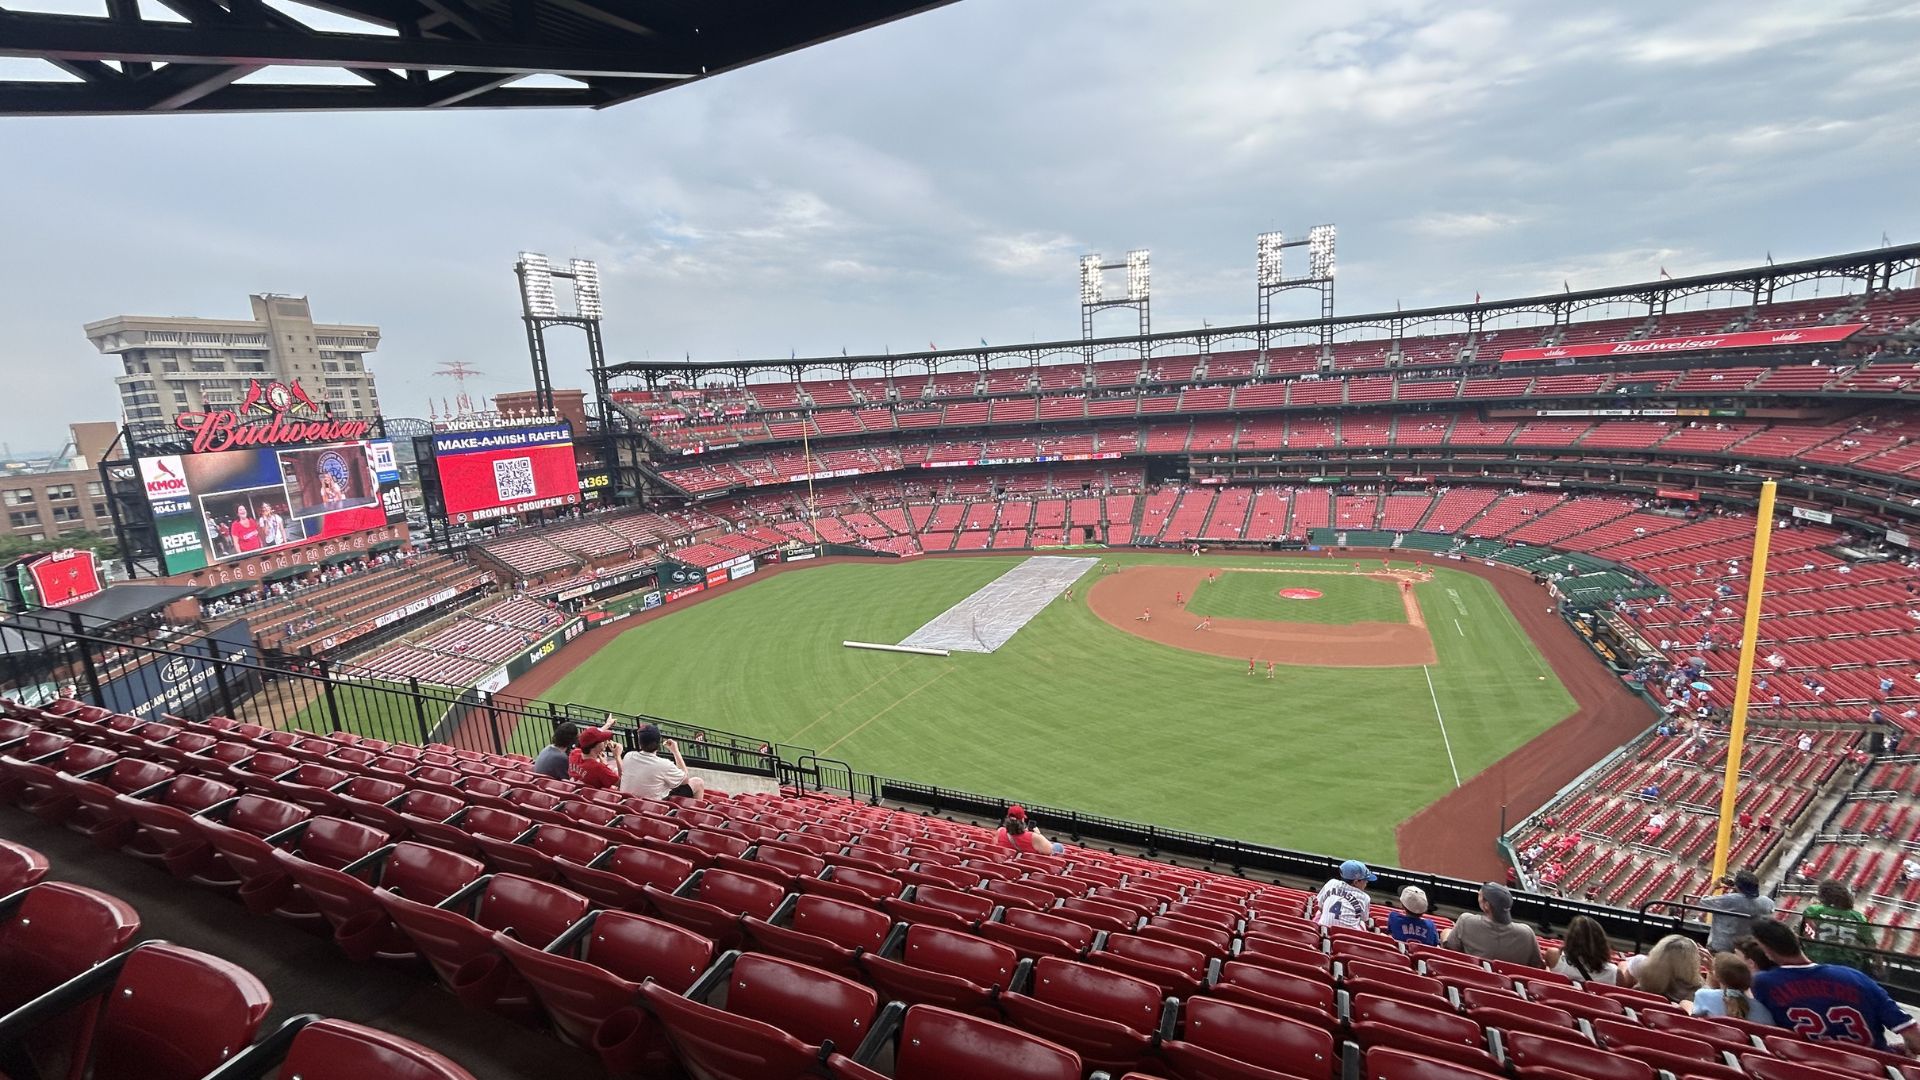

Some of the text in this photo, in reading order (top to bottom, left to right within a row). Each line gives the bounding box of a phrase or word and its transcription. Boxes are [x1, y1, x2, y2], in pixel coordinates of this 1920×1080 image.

[1611, 337, 1726, 353] Budweiser
[177, 409, 368, 453] Budweiser
[437, 430, 570, 451] MAKE-A-WISH RAFFLE
[146, 478, 185, 492] KMOX
[578, 475, 609, 490] et365
[153, 501, 192, 514] 104.1 FM
[472, 498, 562, 521] BROWN & CROUPPEN
[161, 531, 200, 550] REPEL
[220, 570, 230, 584] 2
[233, 567, 243, 580] 6
[247, 564, 256, 576] 9
[260, 560, 272, 573] 10
[276, 556, 288, 569] 14
[291, 552, 302, 565] 17
[306, 548, 319, 561] 20
[324, 544, 337, 557] 23
[353, 536, 365, 548] 42
[529, 640, 556, 664] bet365
[1328, 900, 1342, 920] 4
[1819, 922, 1857, 941] 25
[1786, 1005, 1874, 1046] 23
